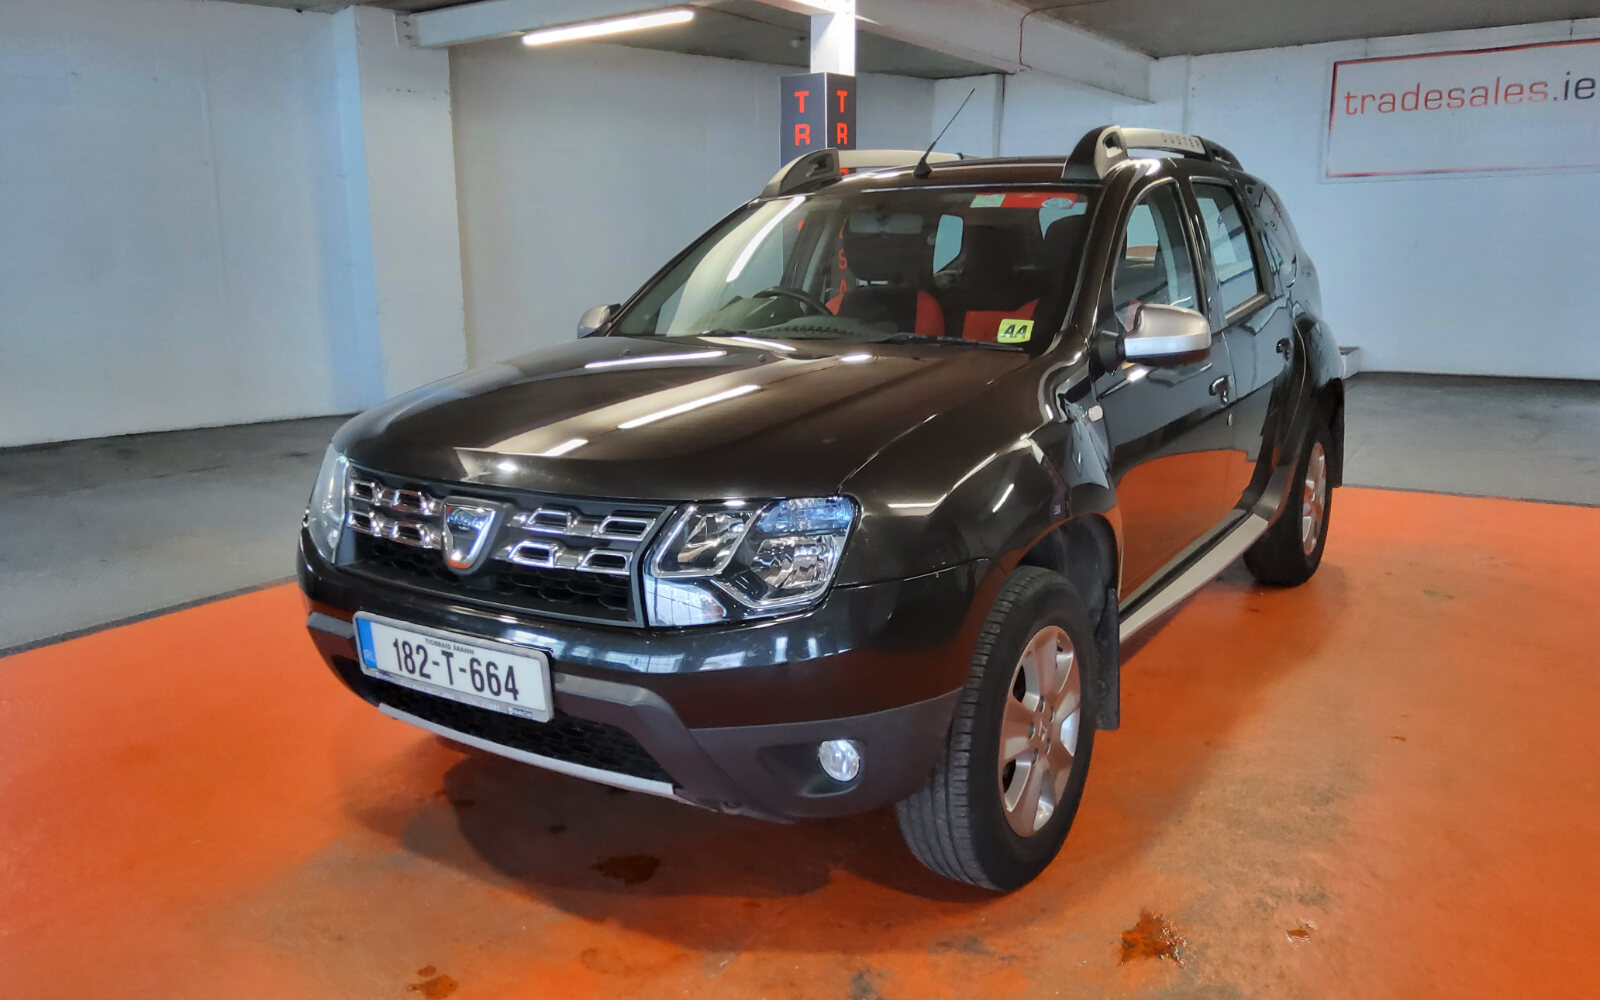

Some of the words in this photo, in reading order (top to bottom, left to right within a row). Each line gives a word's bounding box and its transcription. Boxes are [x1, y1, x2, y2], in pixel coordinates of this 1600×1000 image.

[1344, 71, 1597, 116] tradesales.ie
[1002, 324, 1028, 339] AA
[393, 637, 520, 701] 182-T-664
